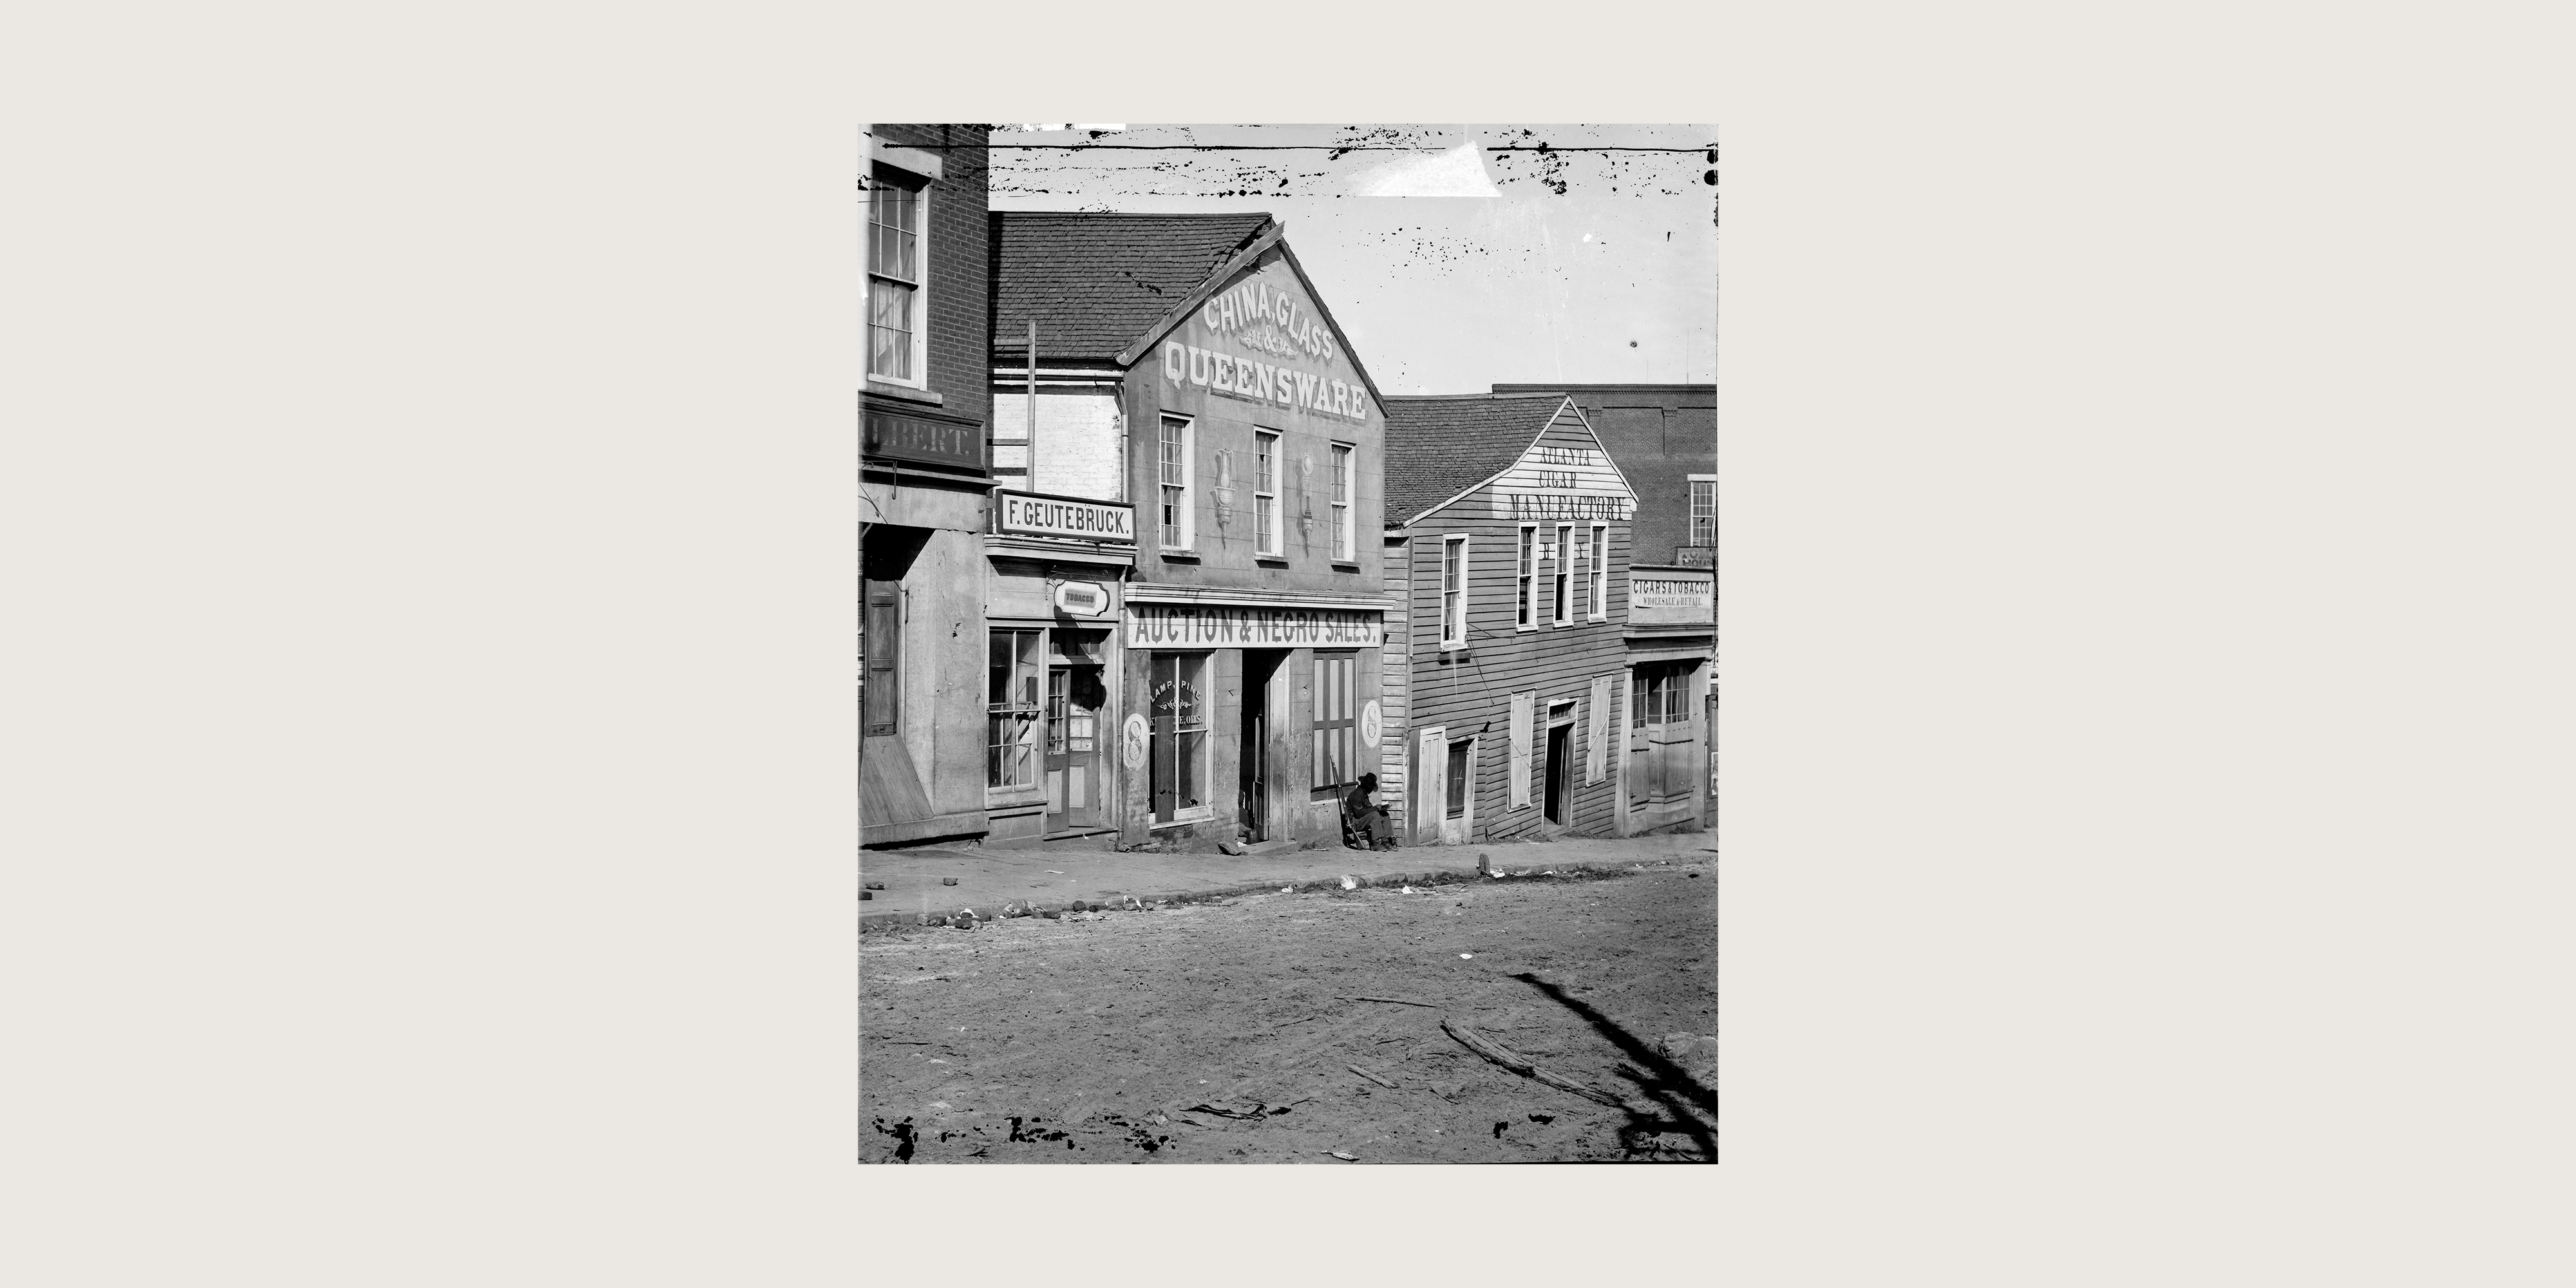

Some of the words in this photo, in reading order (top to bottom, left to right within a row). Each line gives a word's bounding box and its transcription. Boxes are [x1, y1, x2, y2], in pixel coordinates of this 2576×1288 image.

[1276, 290, 1334, 361] GLASS
[1264, 324, 1278, 352] &
[1164, 341, 1366, 421] QUEENSWARE
[1539, 447, 1592, 466] ATLANTA
[1539, 471, 1577, 489] CIGAR
[1009, 500, 1020, 525] F.
[1509, 494, 1626, 520] MANUFACTORY
[1066, 592, 1094, 603] TOBACCO
[1634, 580, 1666, 594] CIGARS
[1673, 582, 1709, 594] TOBACCO
[1643, 597, 1675, 606] WHOLESALE
[1135, 606, 1233, 644] AUCTION
[1239, 609, 1251, 644] &
[1257, 609, 1320, 644] NEGRO
[1325, 611, 1377, 644] SALES.
[1181, 680, 1201, 701] PINE
